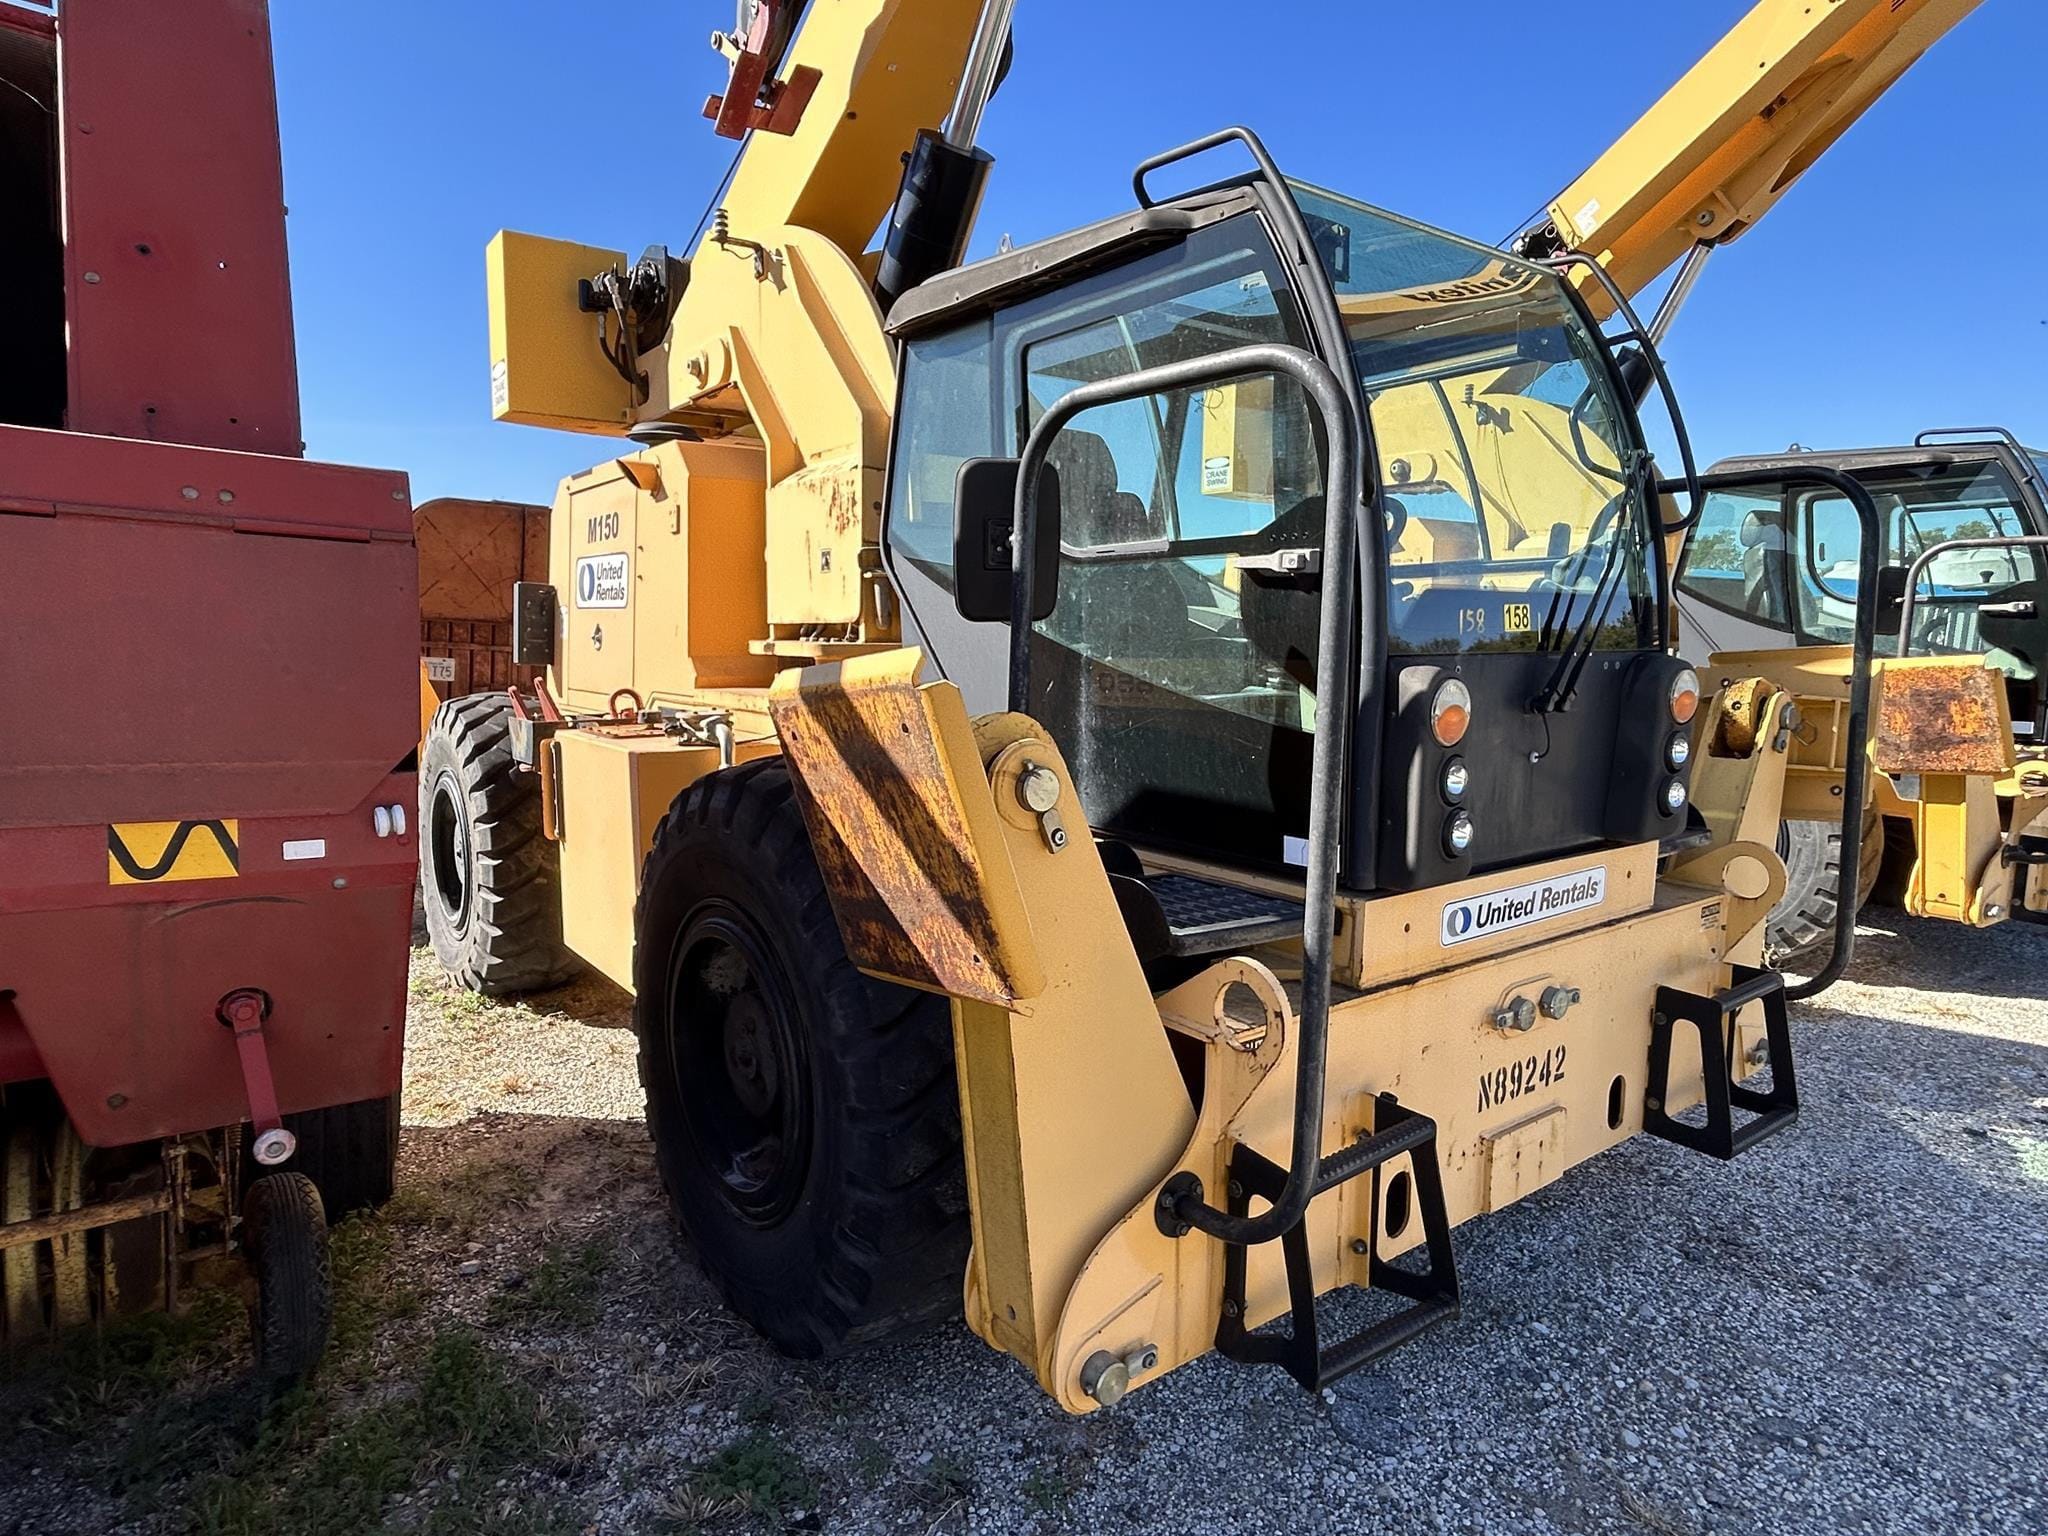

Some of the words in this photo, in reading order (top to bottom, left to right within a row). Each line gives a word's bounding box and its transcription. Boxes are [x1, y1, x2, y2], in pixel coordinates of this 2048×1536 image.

[587, 511, 619, 544] M150
[596, 561, 624, 581] United
[596, 583, 625, 601] Rentals
[1459, 607, 1485, 635] 158
[1505, 604, 1530, 629] 158
[1475, 890, 1537, 929] United
[1539, 876, 1599, 912] Rentals
[1477, 1045, 1567, 1113] N89242
